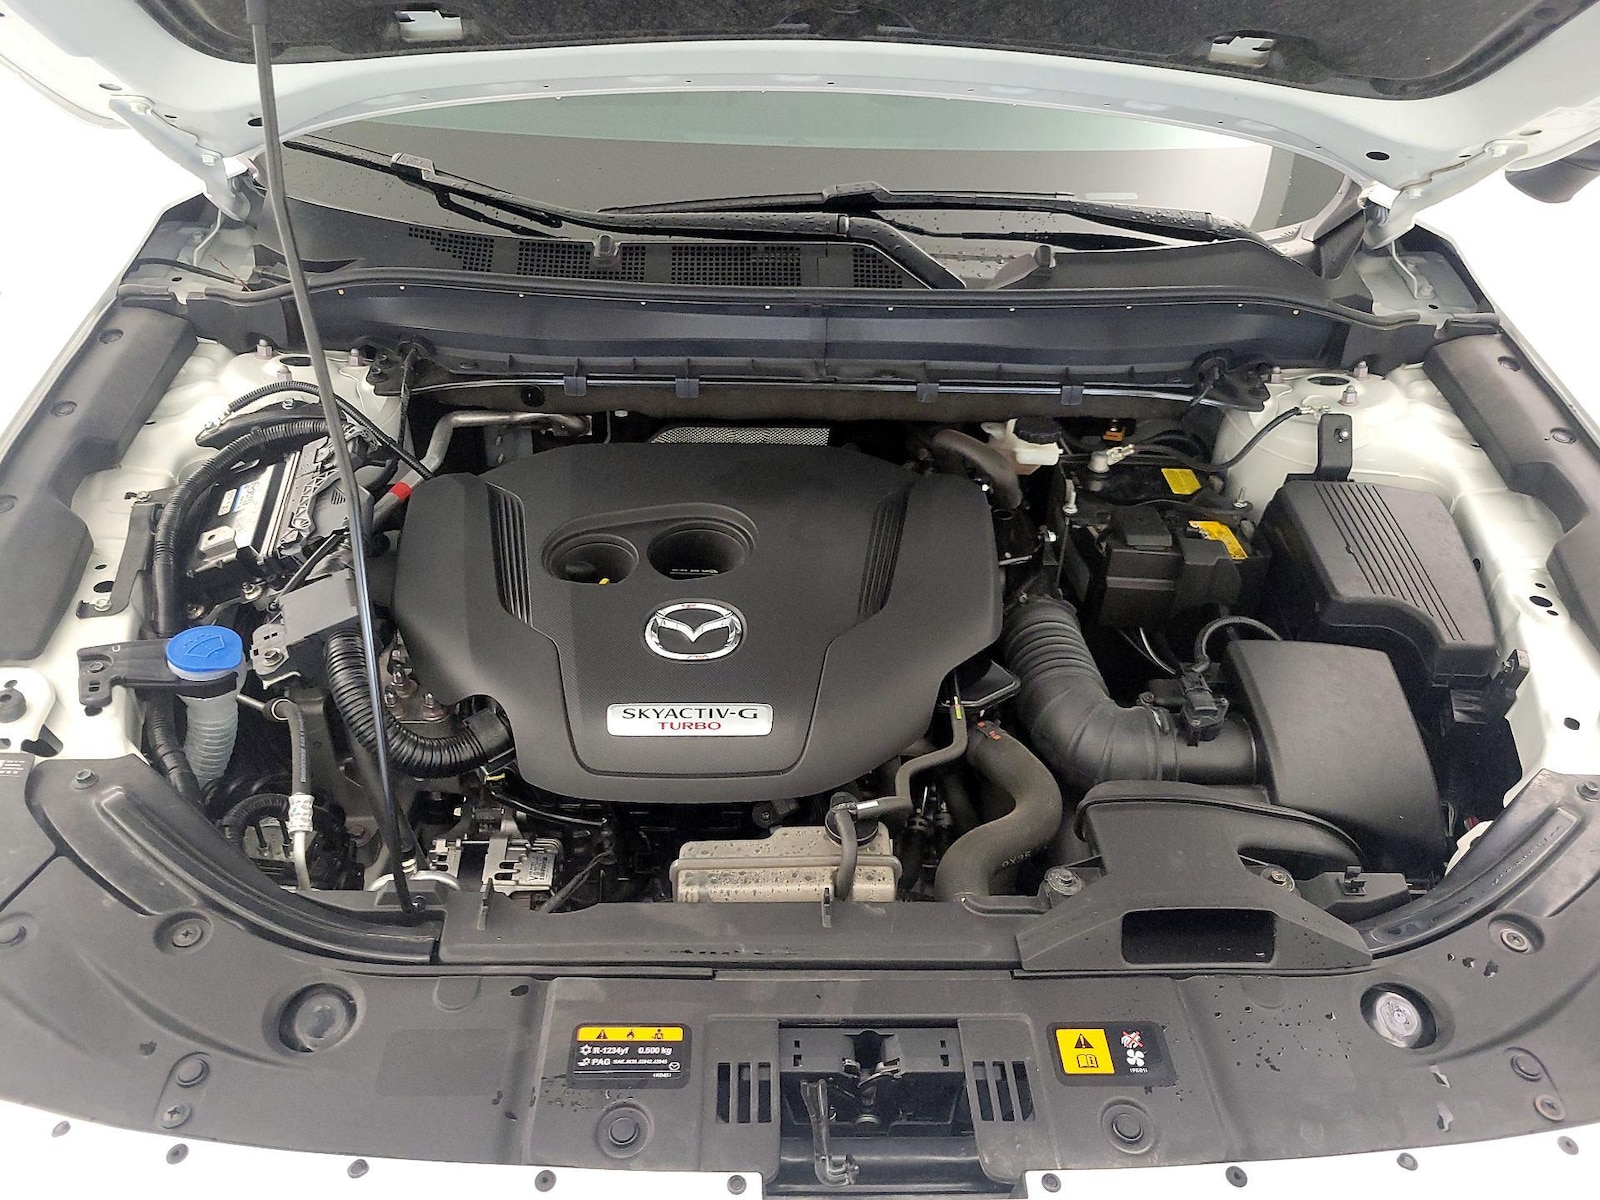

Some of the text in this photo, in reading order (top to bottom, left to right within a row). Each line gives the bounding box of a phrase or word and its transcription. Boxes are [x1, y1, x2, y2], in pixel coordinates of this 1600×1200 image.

[622, 707, 758, 720] SKYACTIV-G
[657, 721, 722, 731] TURBO
[593, 1046, 629, 1055] R-1234yf
[661, 1046, 672, 1055] kg
